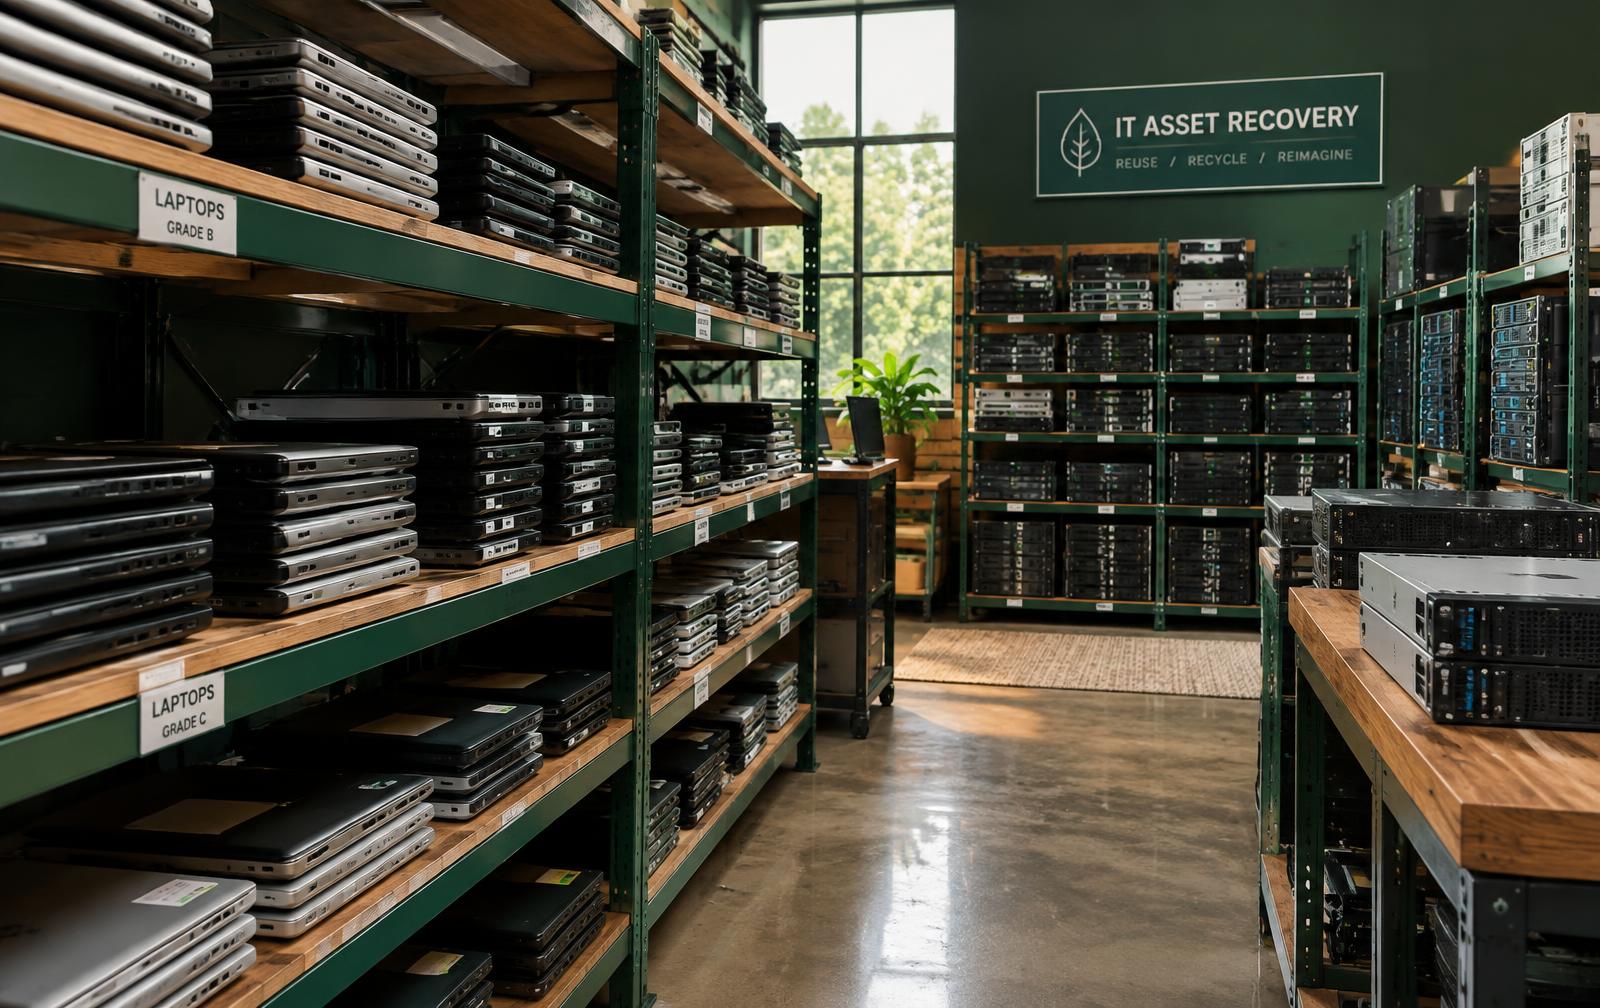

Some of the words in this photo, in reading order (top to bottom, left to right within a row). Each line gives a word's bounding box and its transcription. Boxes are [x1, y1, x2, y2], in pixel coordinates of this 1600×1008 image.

[1116, 116, 1136, 138] IT
[1143, 112, 1220, 136] ASSET
[1227, 105, 1359, 133] RECOVERY
[1115, 156, 1158, 169] REUSE
[1187, 152, 1248, 167] RECYCLE
[1277, 149, 1353, 163] REIMAGINE
[155, 187, 225, 221] LAPTOPS
[167, 220, 204, 240] GRADE
[207, 228, 214, 241] B
[152, 684, 215, 718] LAPTOPS
[162, 715, 197, 738] GRADE
[199, 711, 208, 725] C
